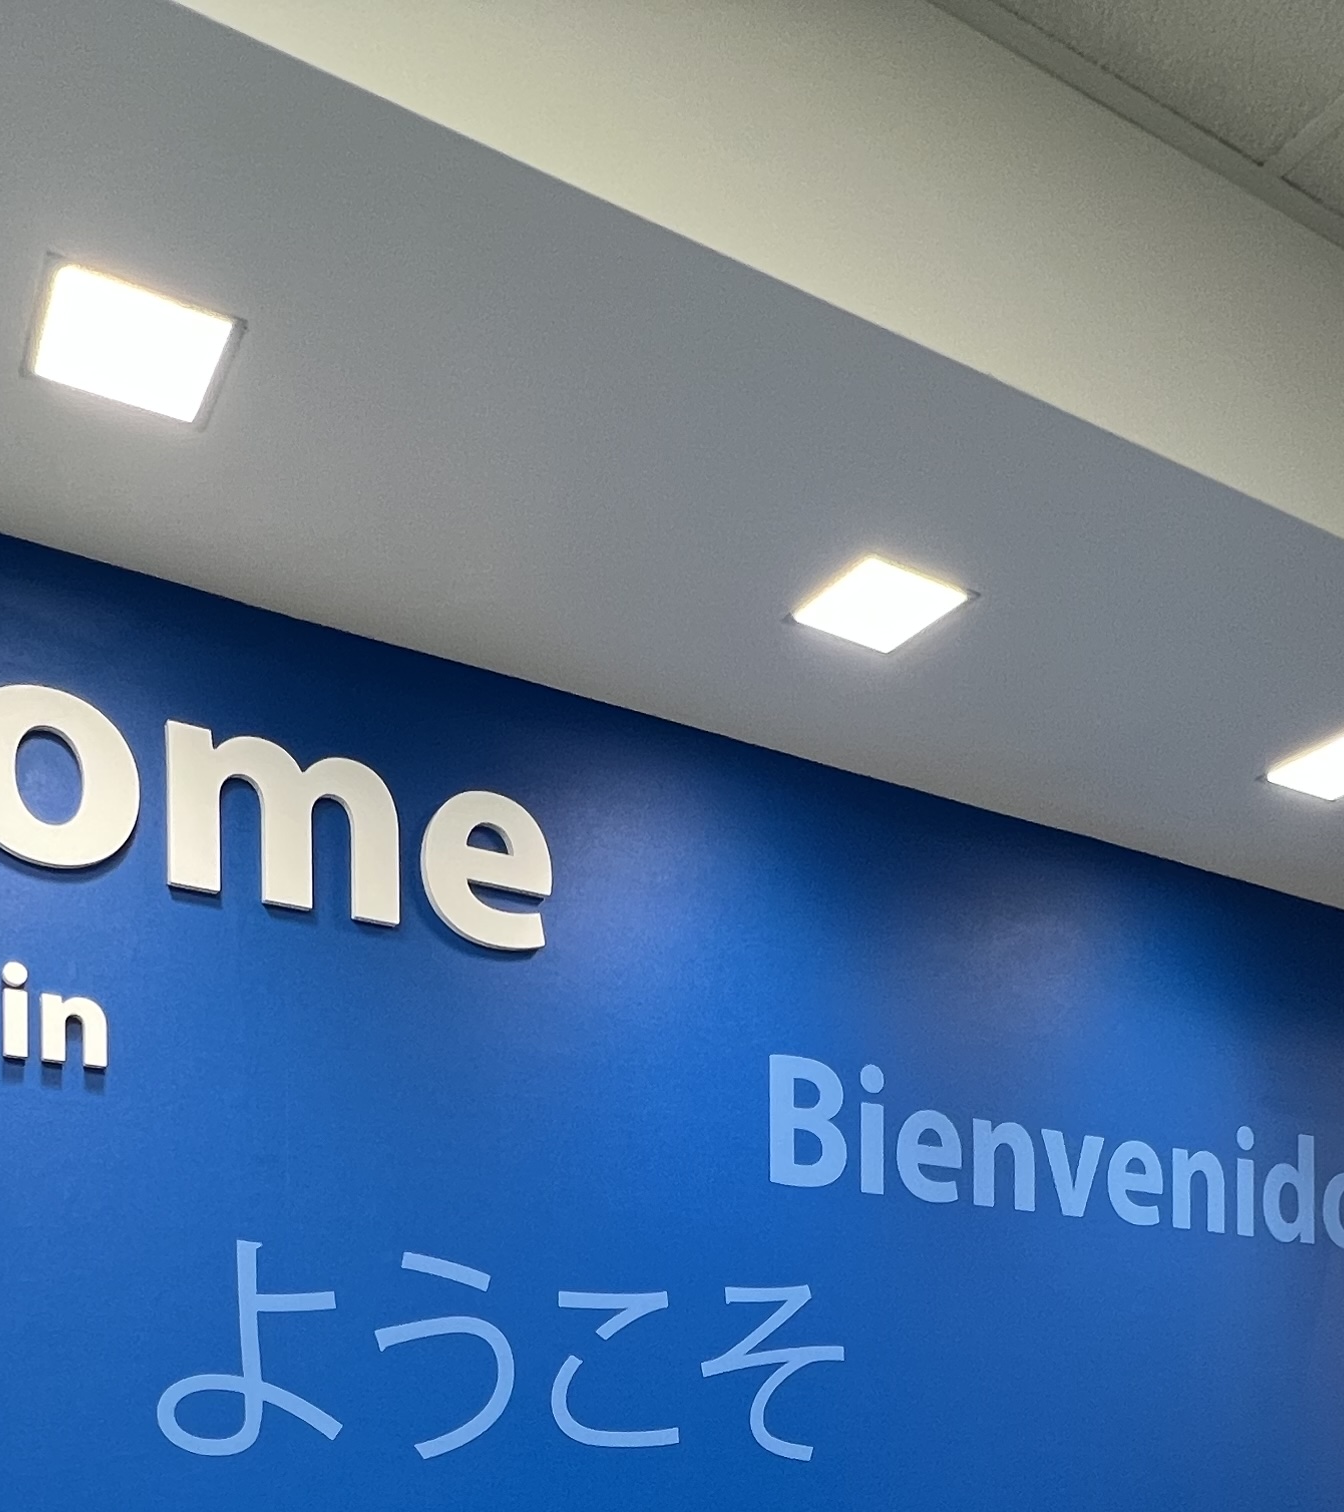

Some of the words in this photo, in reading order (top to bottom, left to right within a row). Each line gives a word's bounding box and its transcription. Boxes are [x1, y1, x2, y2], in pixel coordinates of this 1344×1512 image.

[0, 961, 109, 1071] in
[156, 1240, 845, 1460] ようこそ
